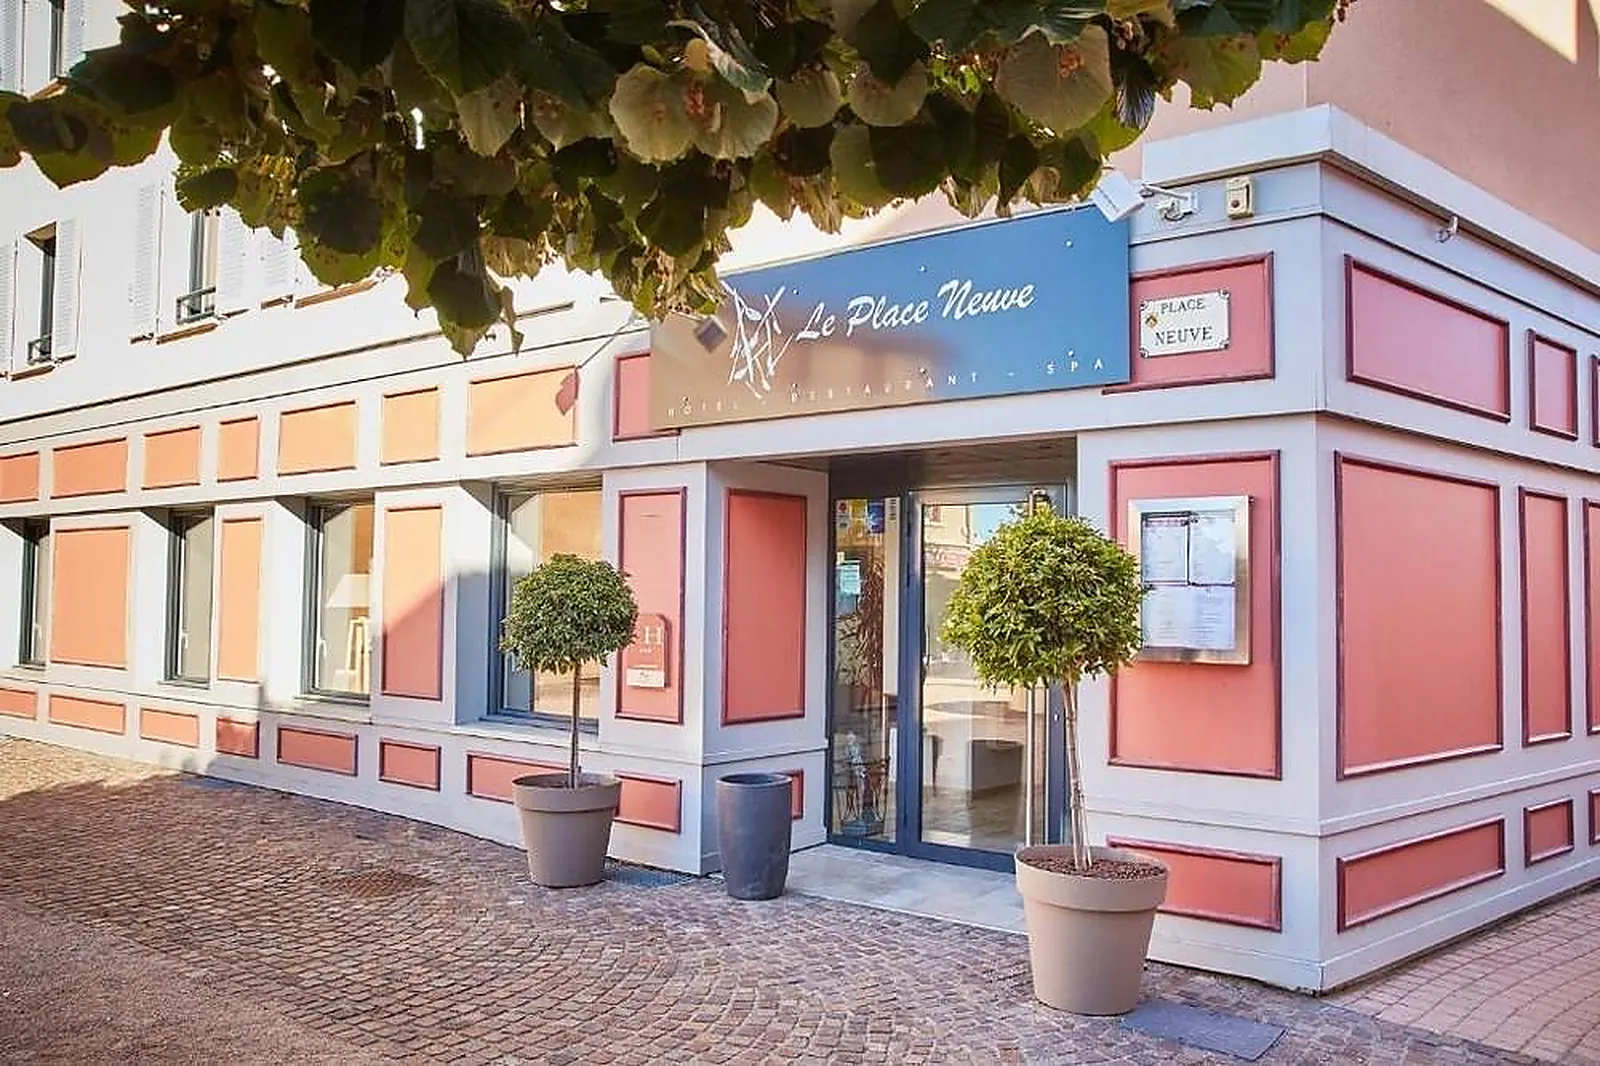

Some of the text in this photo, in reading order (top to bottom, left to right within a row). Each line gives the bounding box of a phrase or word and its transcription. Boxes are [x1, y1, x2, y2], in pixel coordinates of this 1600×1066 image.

[796, 279, 1035, 341] Le Place Neuve
[1160, 298, 1206, 314] PLACE
[1155, 326, 1213, 346] NEUVE
[1045, 358, 1104, 375] SPA
